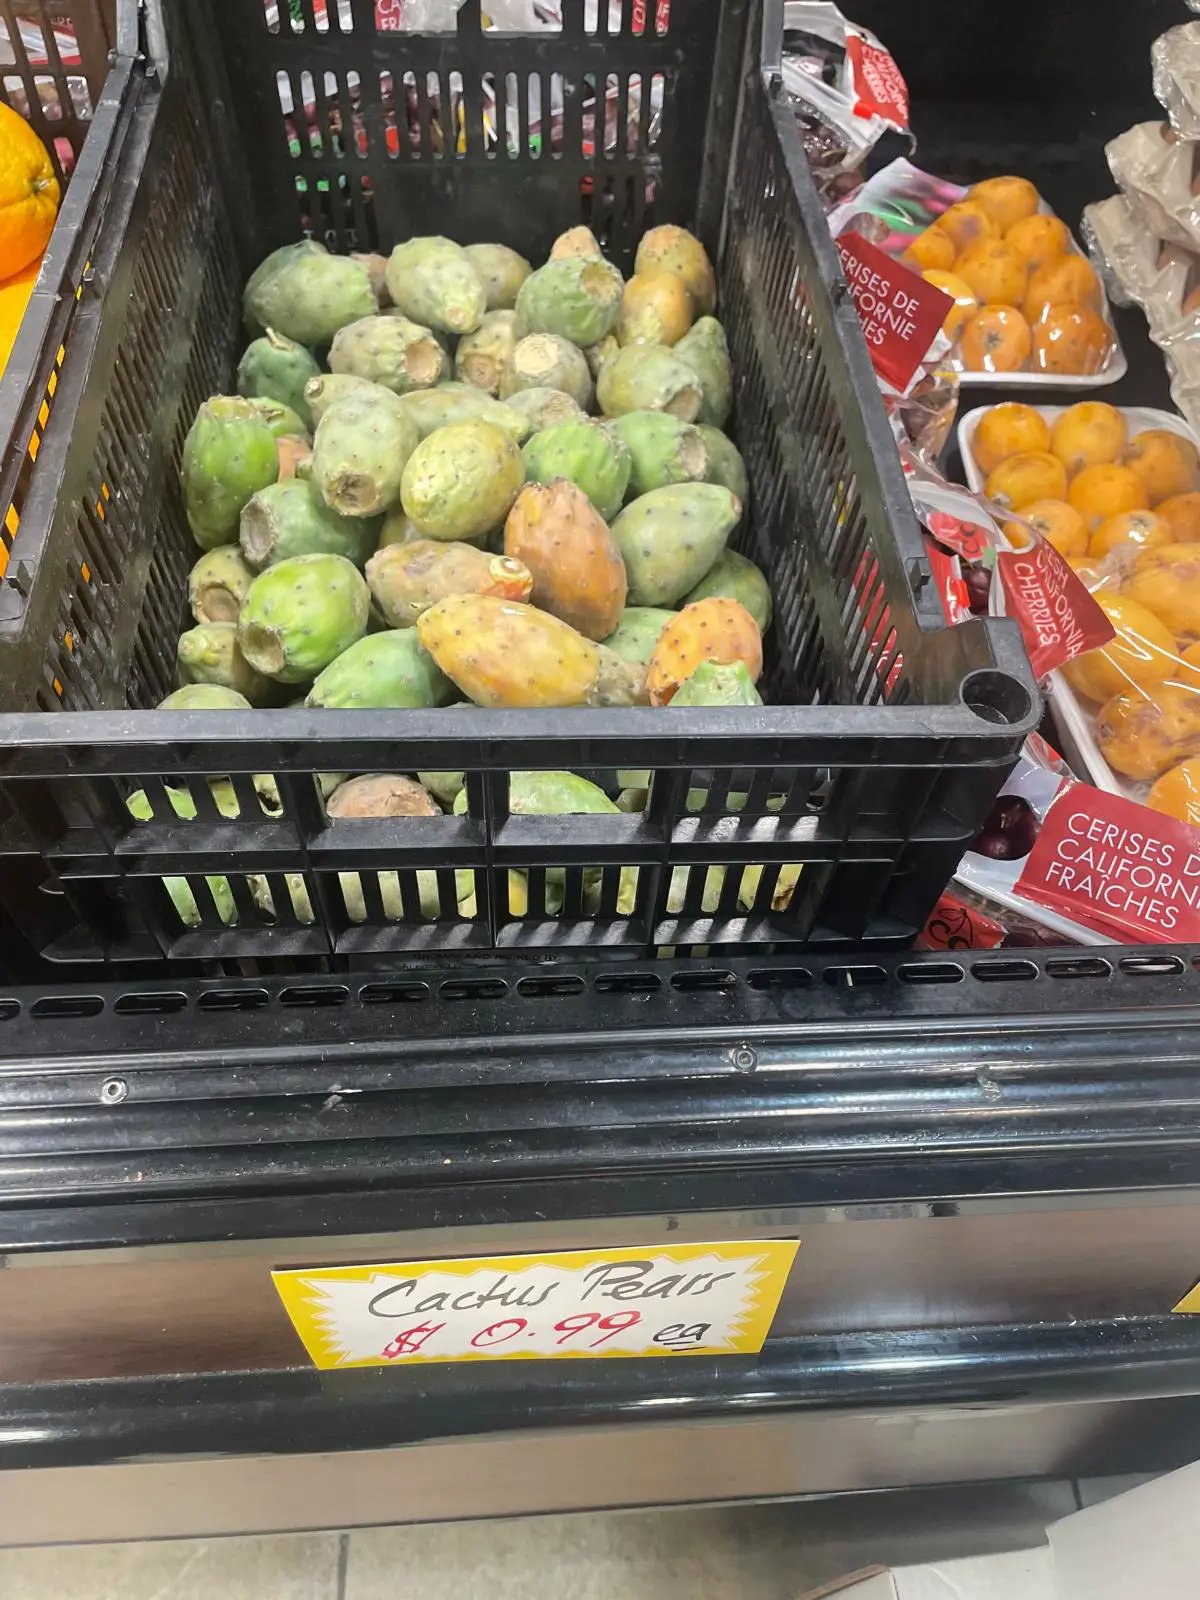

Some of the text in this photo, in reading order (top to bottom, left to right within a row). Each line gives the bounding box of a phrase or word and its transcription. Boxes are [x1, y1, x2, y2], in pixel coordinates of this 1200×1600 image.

[835, 242, 920, 318] ERISES DE
[1014, 562, 1061, 648] CHERRIES
[1057, 838, 1200, 909] CALIFORN
[1068, 813, 1200, 877] CERISES D
[1045, 861, 1180, 928] FRAÎCHES
[368, 1261, 736, 1318] Cactus Pears
[653, 1322, 712, 1343] ea
